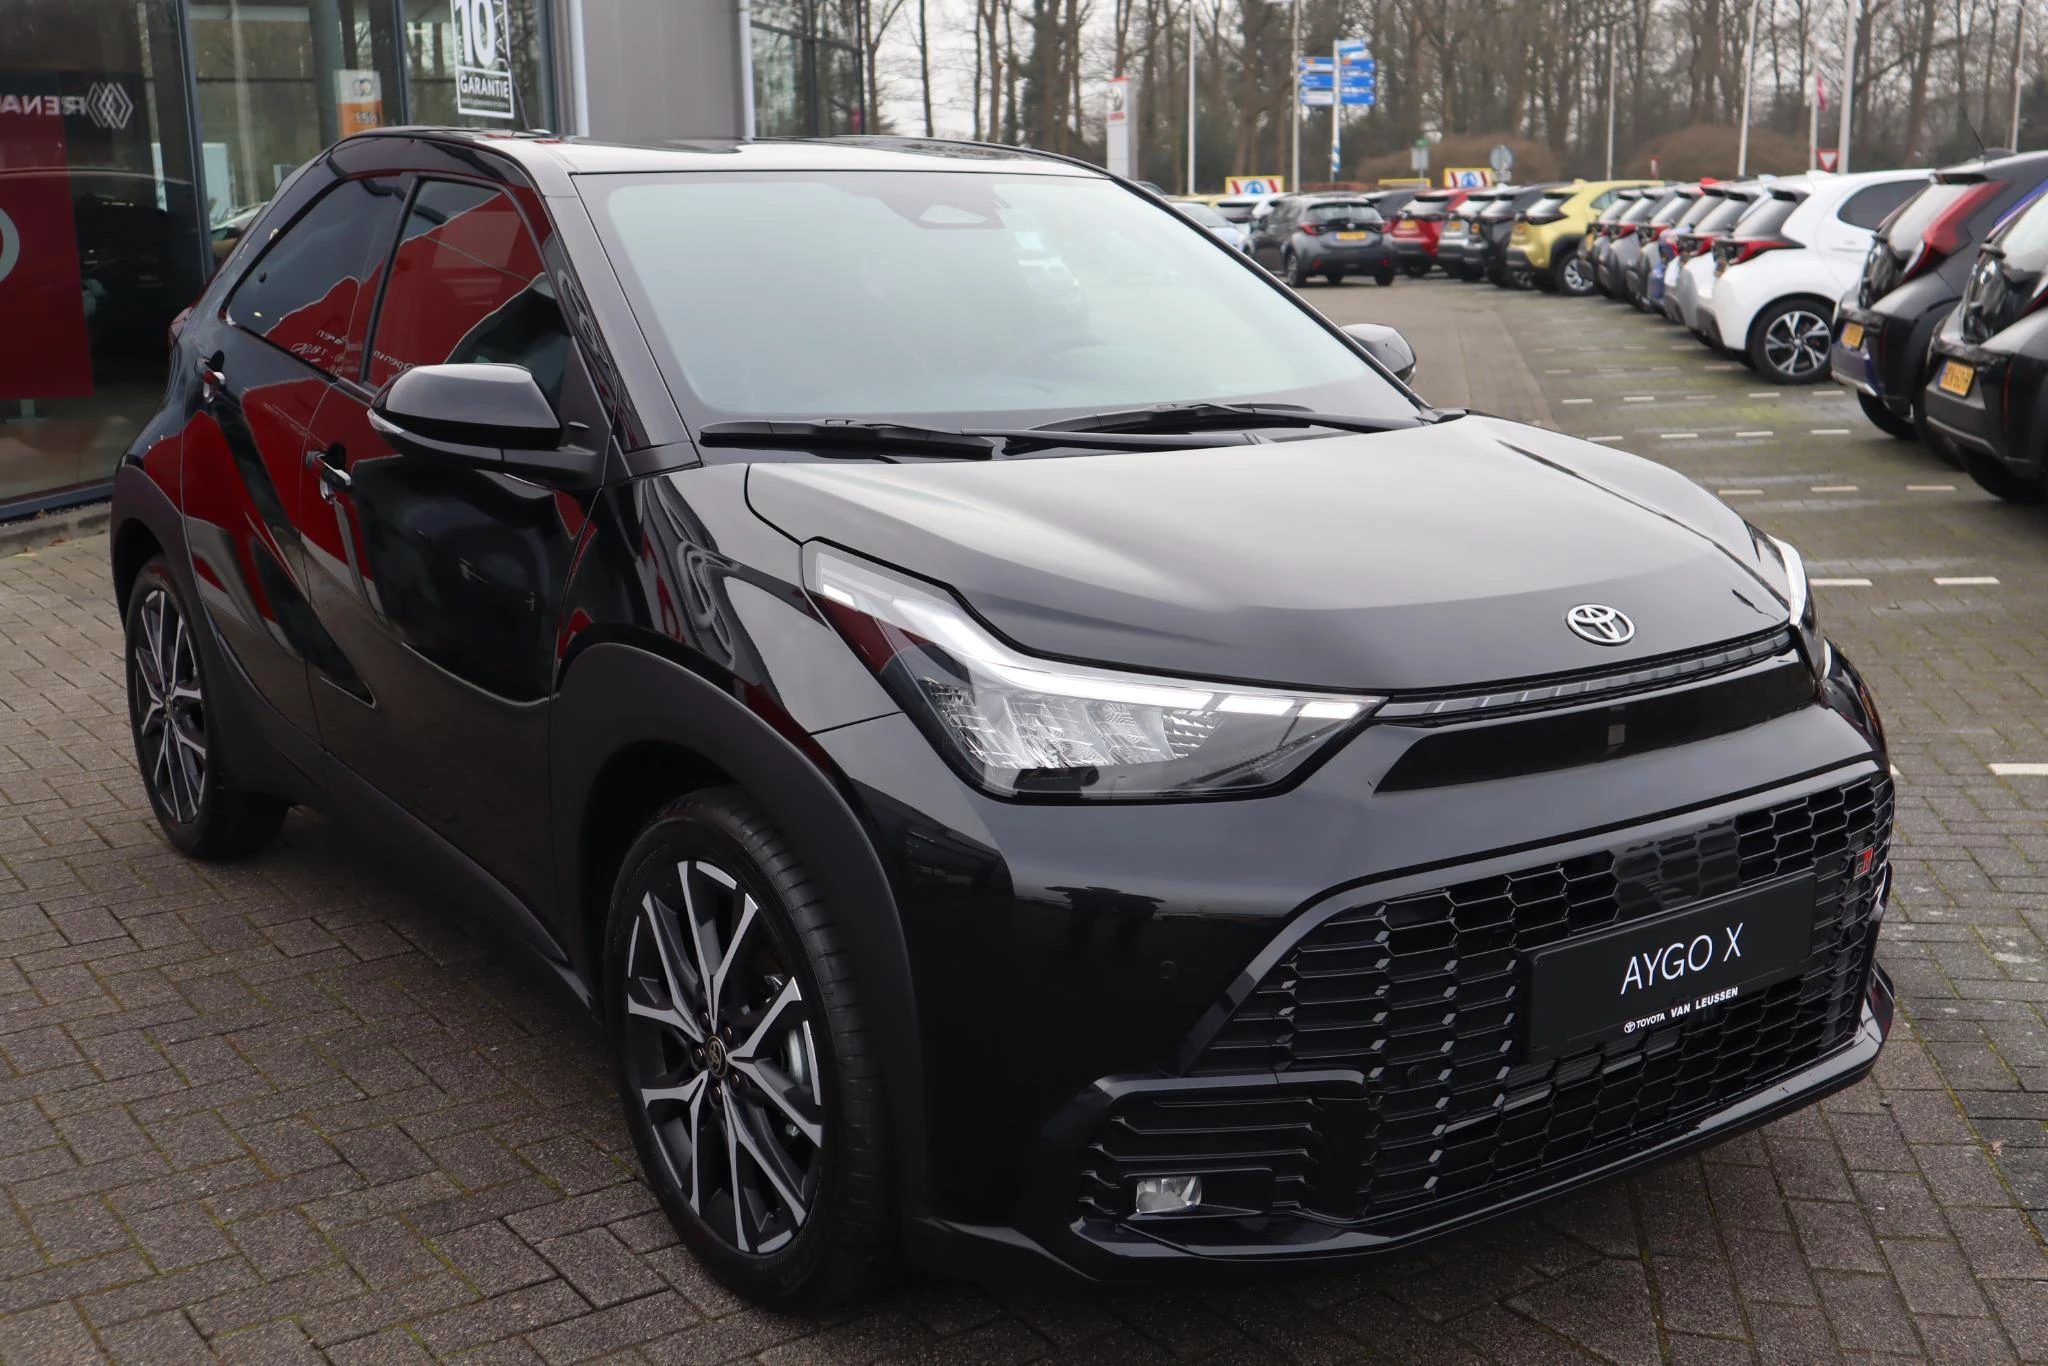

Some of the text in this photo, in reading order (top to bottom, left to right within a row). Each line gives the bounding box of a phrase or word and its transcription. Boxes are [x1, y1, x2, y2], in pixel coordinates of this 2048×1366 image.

[454, 0, 496, 68] 10
[460, 75, 510, 98] GARANTIE
[1620, 922, 1743, 995] AYGO X
[1636, 986, 1738, 1029] TOYOTA VAN LEUSSEN
